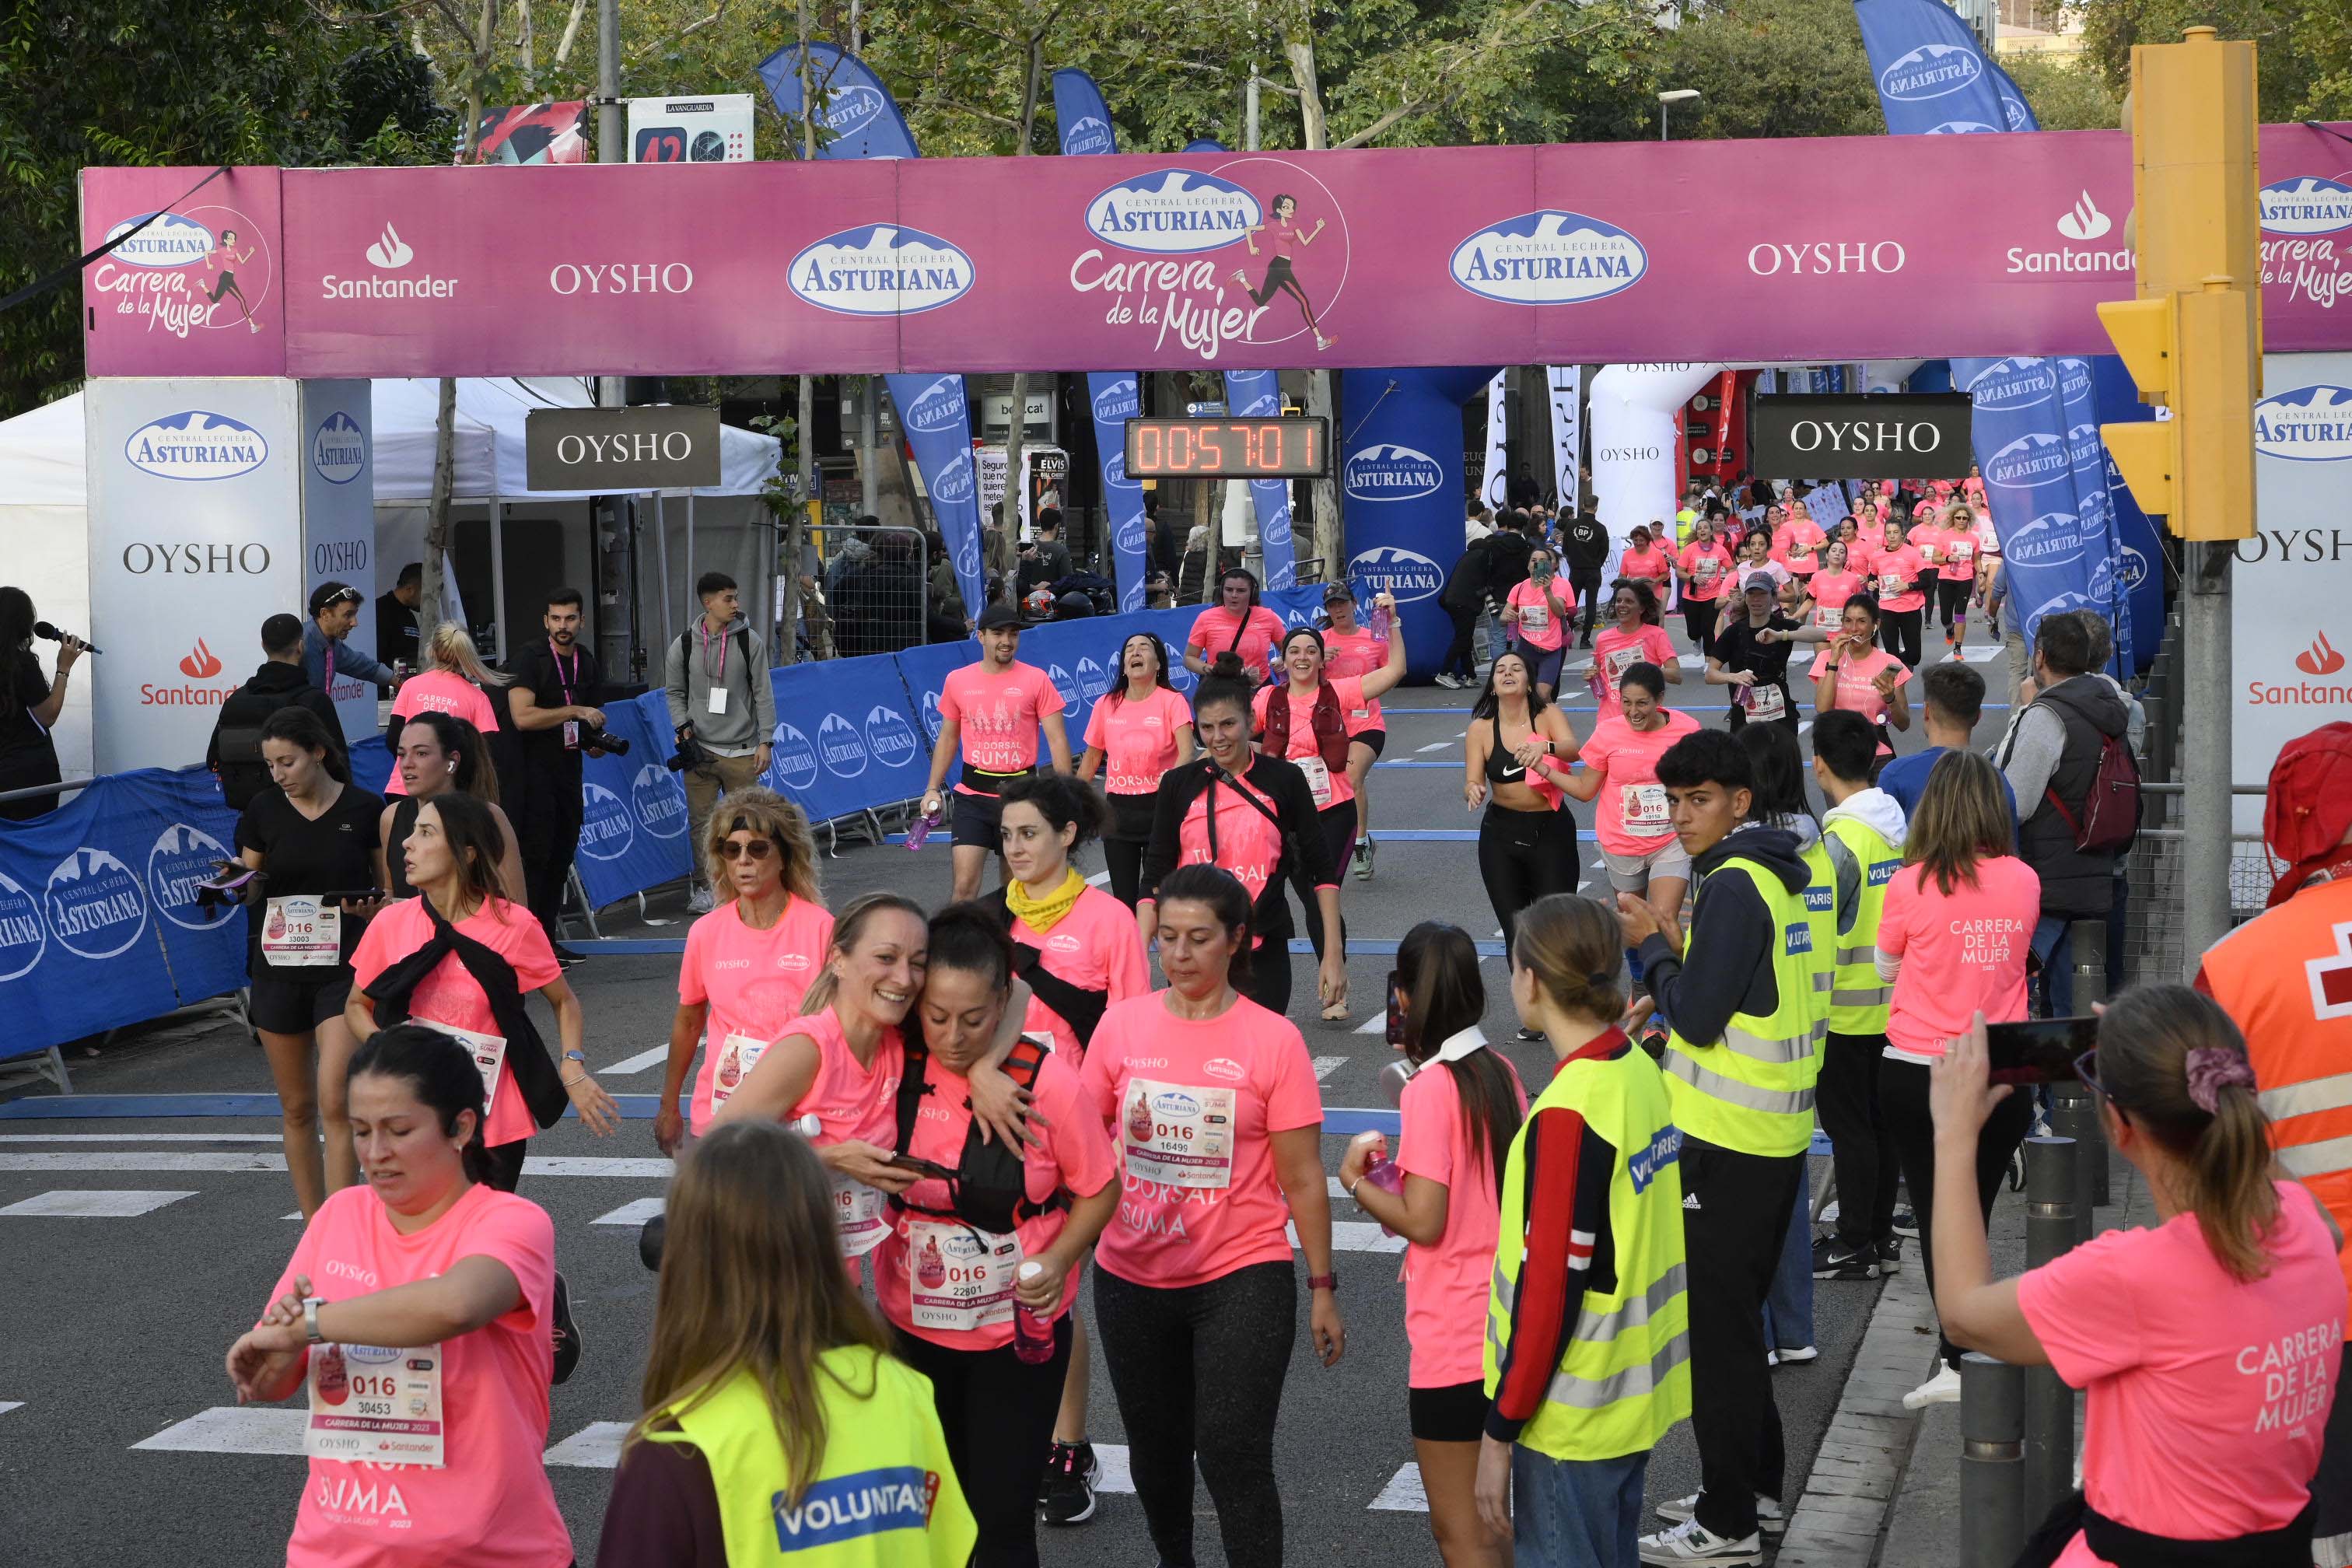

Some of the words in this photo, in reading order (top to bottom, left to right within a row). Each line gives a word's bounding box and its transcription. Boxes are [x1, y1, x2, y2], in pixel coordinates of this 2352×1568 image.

[1125, 198, 1180, 207] CENTRAL
[1186, 198, 1244, 206] LECHERA
[1099, 201, 1248, 233] ASTURIANA
[1496, 243, 1556, 253] CENTRAL
[1563, 242, 1626, 251] LECHERA
[2259, 239, 2334, 261] arrera
[831, 255, 889, 264] CENTRAL
[895, 254, 954, 264] LECHERA
[1465, 247, 1632, 281] ASTURIANA
[1748, 241, 1906, 275] OYSHO
[94, 263, 187, 293] Carrera
[802, 258, 960, 292] ASTURIANA
[1070, 249, 1216, 292] Carrera
[550, 263, 693, 294] OYSHO
[2278, 262, 2292, 284] la
[2289, 257, 2352, 308] Muje
[322, 275, 458, 299] Santander
[117, 295, 134, 314] de
[138, 292, 150, 314] la
[148, 289, 220, 338] Mujer
[1106, 295, 1133, 325] de
[1139, 295, 1158, 324] la
[1154, 287, 1270, 360] Mujer
[1790, 421, 1941, 453] OYSHO
[137, 437, 257, 464] ASTURIANA
[557, 432, 691, 464] OYSHO
[1139, 425, 1312, 468] 00:57:01
[317, 443, 362, 466] ASTURIANA
[1601, 447, 1660, 462] OYSHO
[1041, 459, 1065, 470] ELVIS
[983, 474, 995, 482] que
[1348, 467, 1435, 488] ASTURIANA
[123, 543, 270, 574] OYSHO
[315, 540, 367, 574] OYSHO
[1365, 575, 1436, 590] TURIANA
[330, 681, 364, 702] ntander
[1838, 681, 1878, 691] movemen
[416, 693, 459, 708] CARRERA
[423, 702, 434, 711] DE
[438, 705, 449, 713] LA
[822, 740, 865, 765] ASTURIANA
[983, 741, 1022, 750] DORSAL
[775, 750, 816, 775] ASTURIANA
[971, 750, 1022, 765] SUMA
[1643, 804, 1662, 813] 016
[0, 898, 26, 911] ECHERA
[288, 923, 313, 933] 016
[1950, 919, 2023, 934] CARRERA
[1965, 934, 1986, 948] DE
[1992, 933, 2009, 947] LA
[1962, 948, 2011, 964] MUJER
[716, 959, 749, 971] OYSHO
[1124, 1056, 1168, 1069] OYSHO
[1155, 1099, 1198, 1114] ASTURIANA
[918, 1107, 950, 1122] YSHO
[1157, 1124, 1193, 1139] 016
[1160, 1142, 1188, 1153] 16499
[1135, 1163, 1161, 1175] OYSHO
[1187, 1171, 1222, 1180] Santander
[1125, 1175, 1219, 1205] DORSAL
[1122, 1202, 1187, 1237] SUMA
[325, 1259, 377, 1288] OYSHO
[949, 1265, 986, 1283] 016
[954, 1285, 982, 1297] 22801
[924, 1297, 955, 1307] CARRERA
[922, 1311, 957, 1321] OYSHO
[2236, 1317, 2341, 1375] CARRERA
[352, 1376, 396, 1395] 016
[2266, 1367, 2298, 1402] DE
[2305, 1356, 2328, 1388] LA
[359, 1402, 391, 1415] 30453
[2255, 1384, 2327, 1433] MUJER
[325, 1419, 359, 1428] CARRERA
[382, 1422, 410, 1431] MUJER
[319, 1437, 360, 1450] OYSHO
[390, 1441, 434, 1452] Santander
